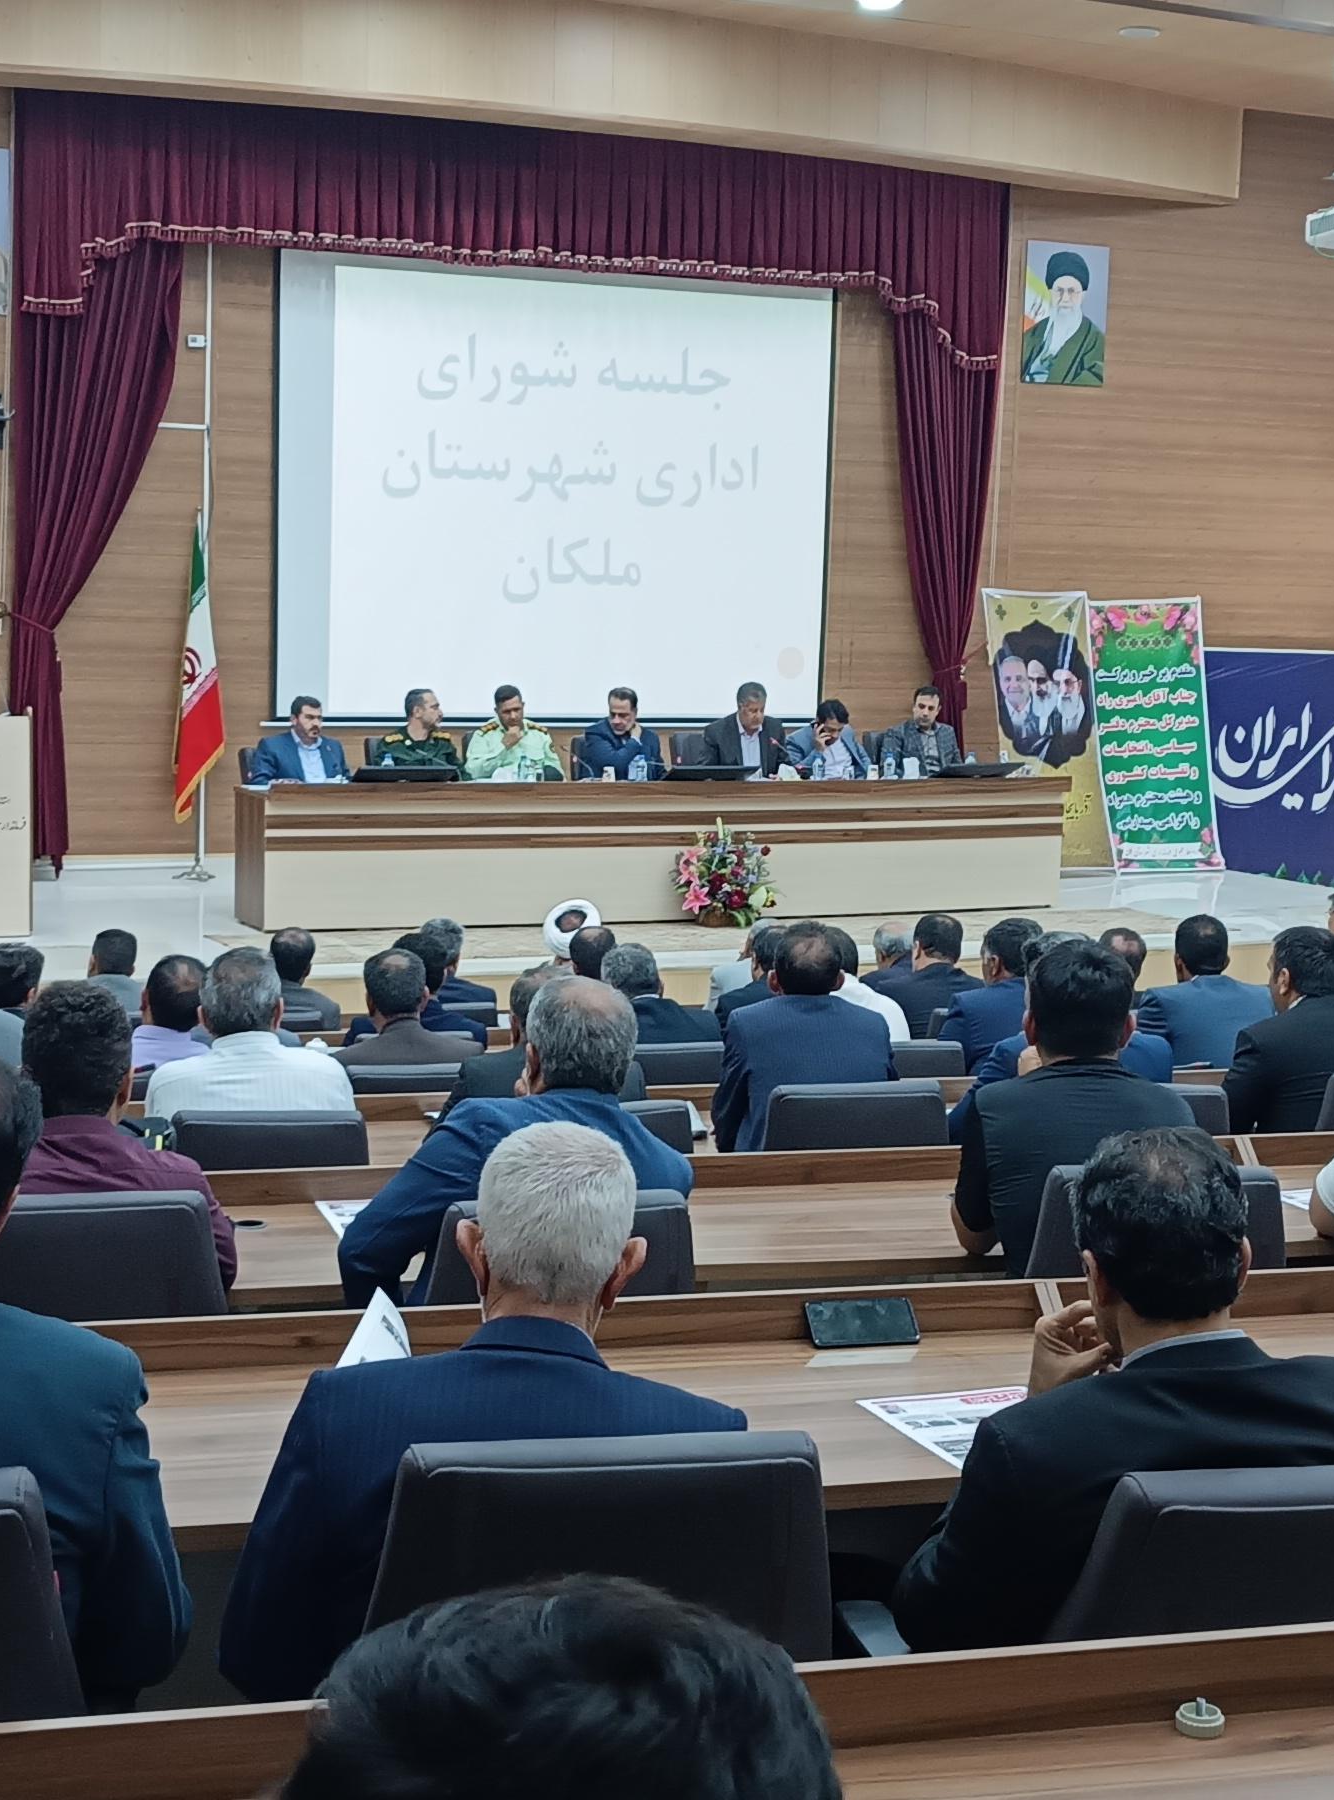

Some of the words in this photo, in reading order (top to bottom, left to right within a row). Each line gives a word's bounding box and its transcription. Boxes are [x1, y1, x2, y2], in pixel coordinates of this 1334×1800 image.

[417, 333, 578, 406] شورای
[597, 347, 731, 411] جلسه
[382, 430, 617, 502] شهرستان
[635, 443, 759, 507] اداری
[502, 537, 643, 603] ملکان
[1138, 664, 1157, 682] خیر
[1169, 663, 1196, 681] مقدم
[1142, 687, 1169, 708] آقای
[1169, 688, 1197, 705] جناب
[1098, 716, 1127, 735] دفتر
[1127, 717, 1158, 733] محترم
[1158, 713, 1175, 731] کل
[1173, 714, 1199, 731] مدیر
[1154, 738, 1197, 758] سیاسی
[1215, 702, 1313, 780] ایران
[1105, 764, 1148, 785] کشوری
[1148, 763, 1189, 780] تقسیمات
[1135, 790, 1167, 807] محترم
[1156, 812, 1188, 831] گرامی
